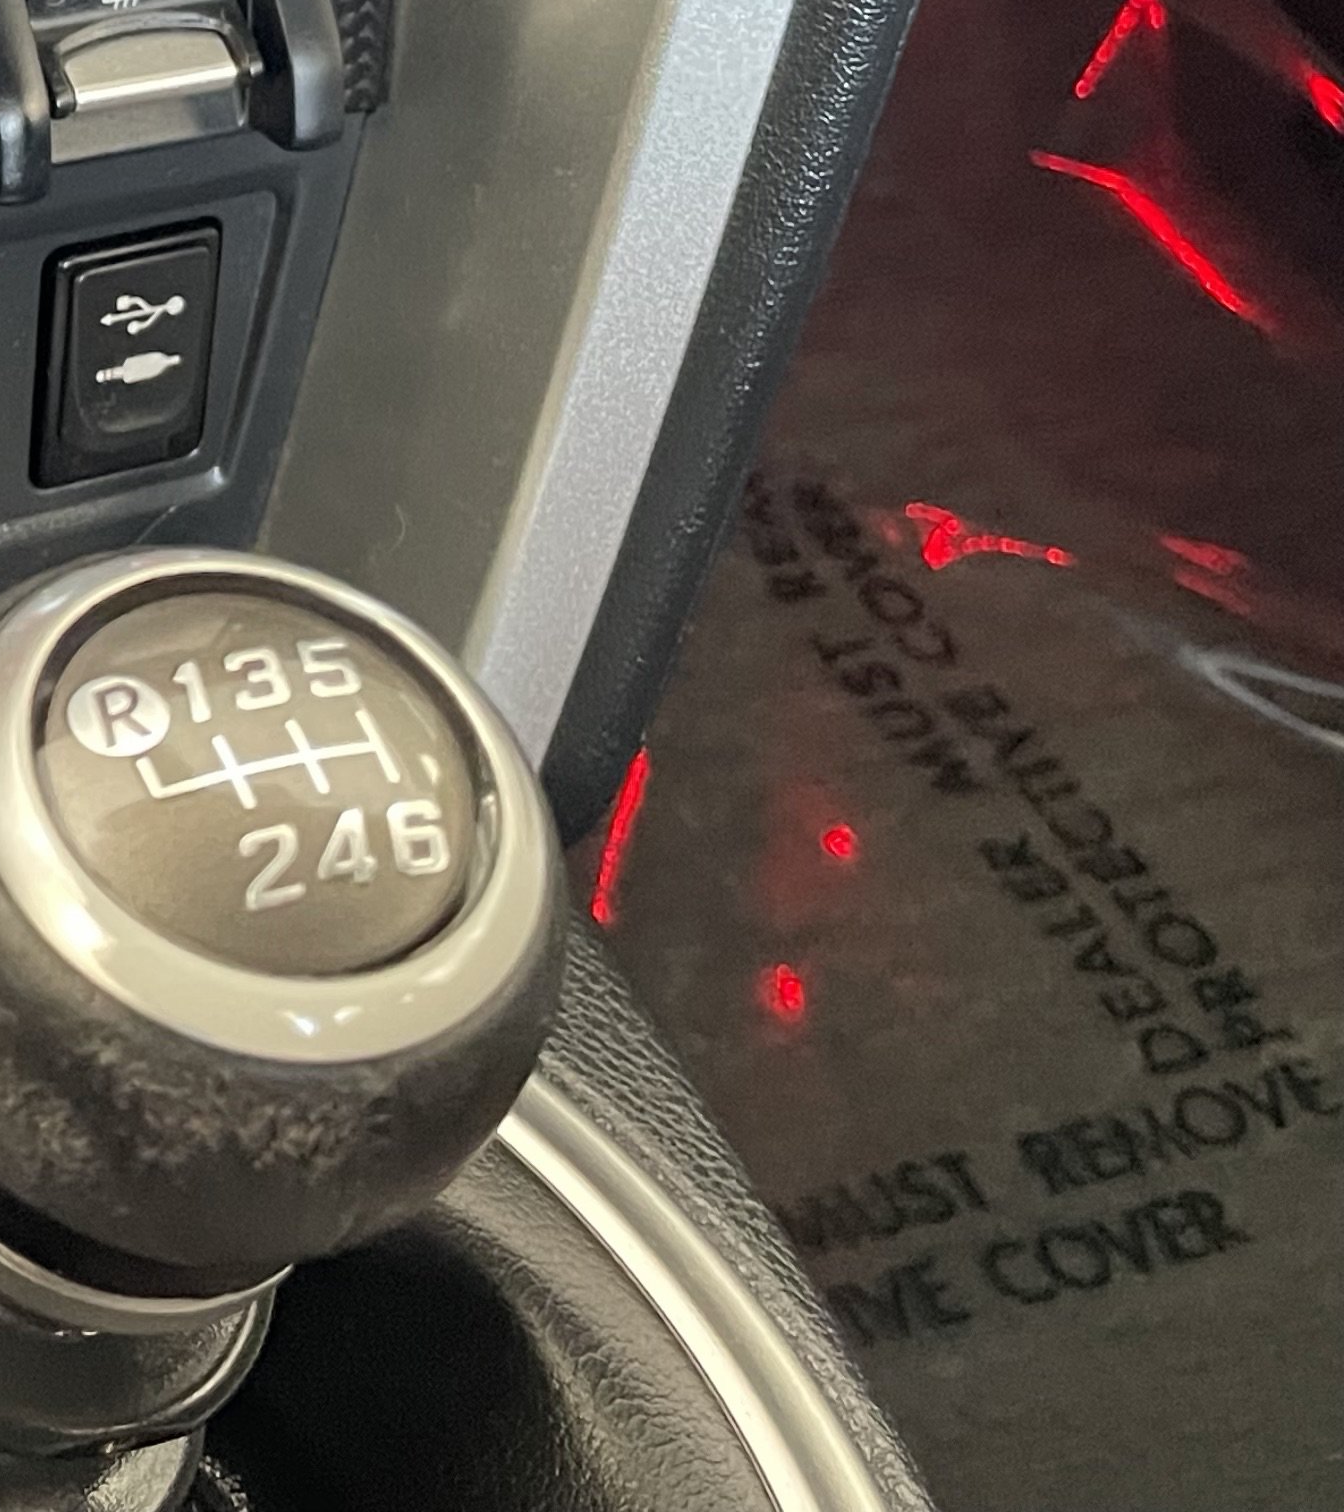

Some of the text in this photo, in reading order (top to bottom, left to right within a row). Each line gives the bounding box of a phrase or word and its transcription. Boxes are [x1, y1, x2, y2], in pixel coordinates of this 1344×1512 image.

[170, 659, 212, 723] 1
[222, 647, 292, 711] 3
[295, 636, 363, 698] 5
[238, 797, 452, 912] 2 4 6
[980, 1191, 1252, 1305] COVER
